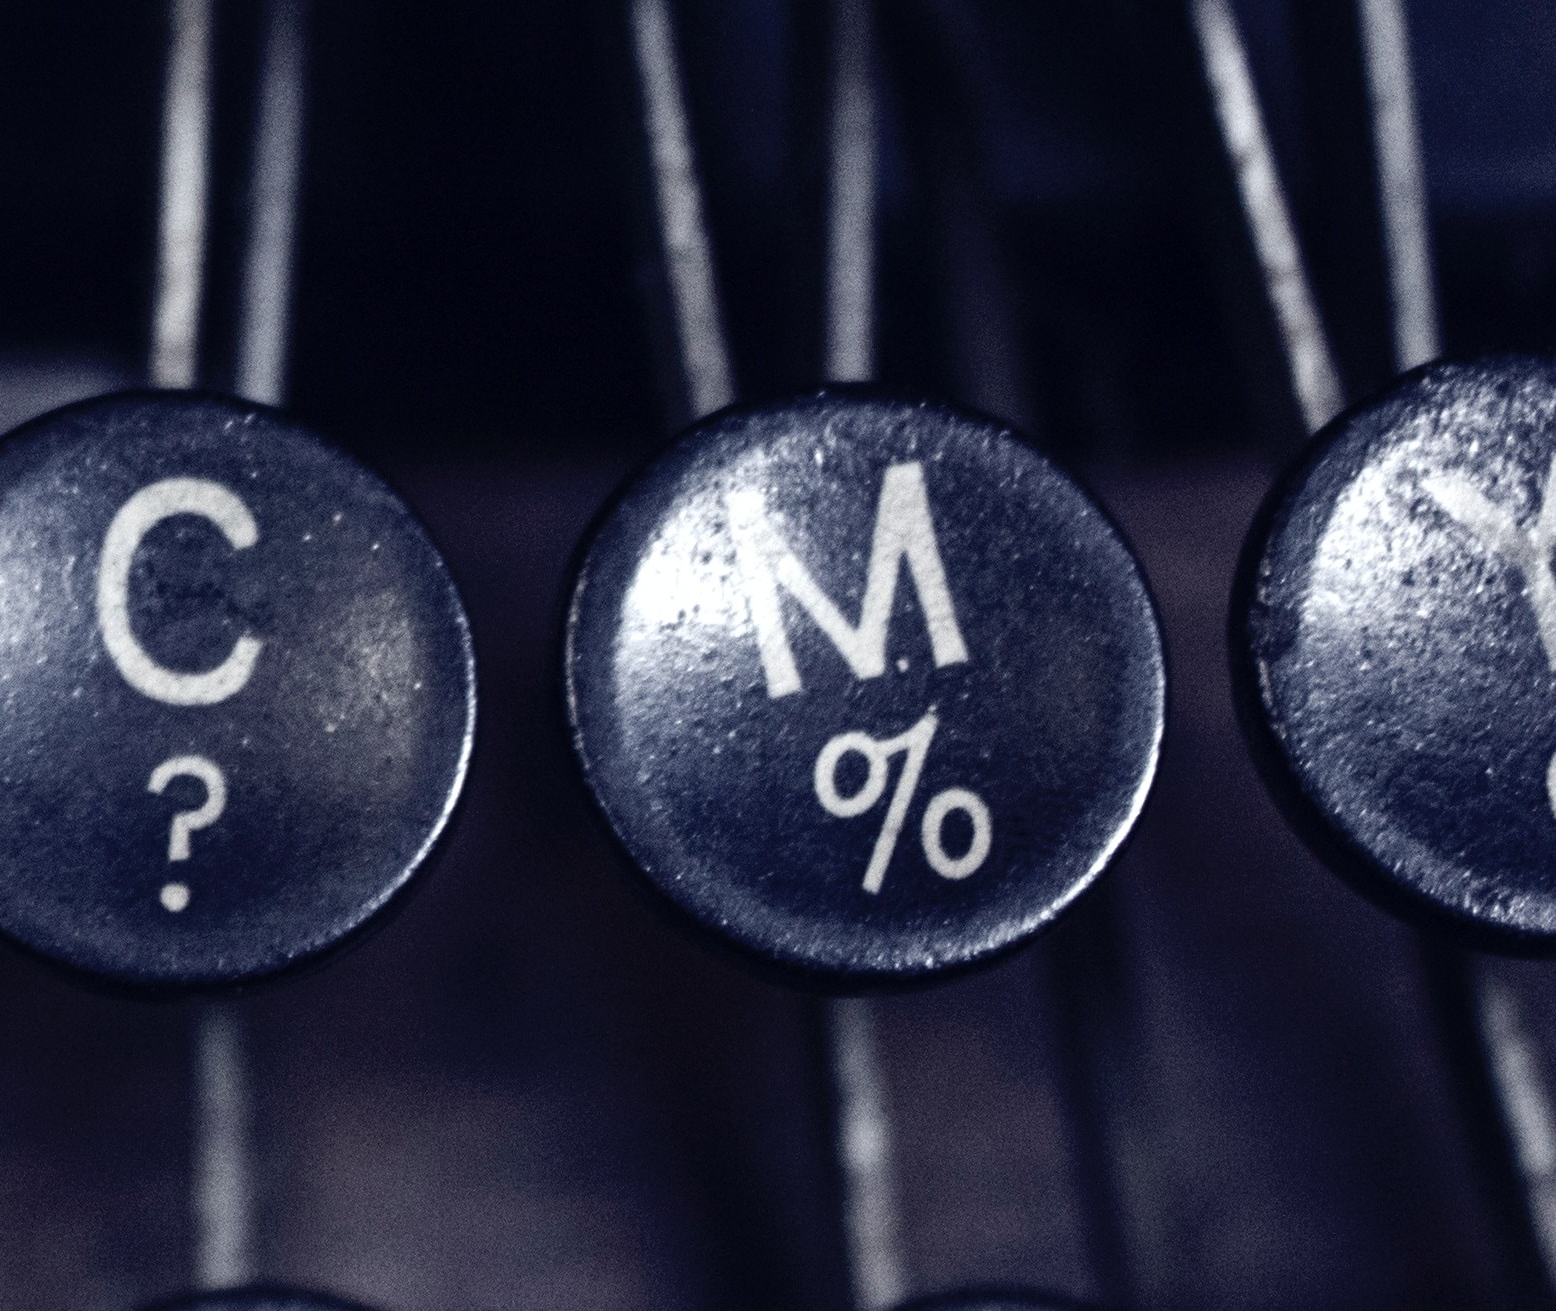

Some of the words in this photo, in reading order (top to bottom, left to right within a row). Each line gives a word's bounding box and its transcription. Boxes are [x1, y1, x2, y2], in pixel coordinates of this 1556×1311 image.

[95, 478, 265, 706] C
[724, 460, 969, 699] M
[147, 755, 227, 913] ?
[812, 703, 992, 895] %
